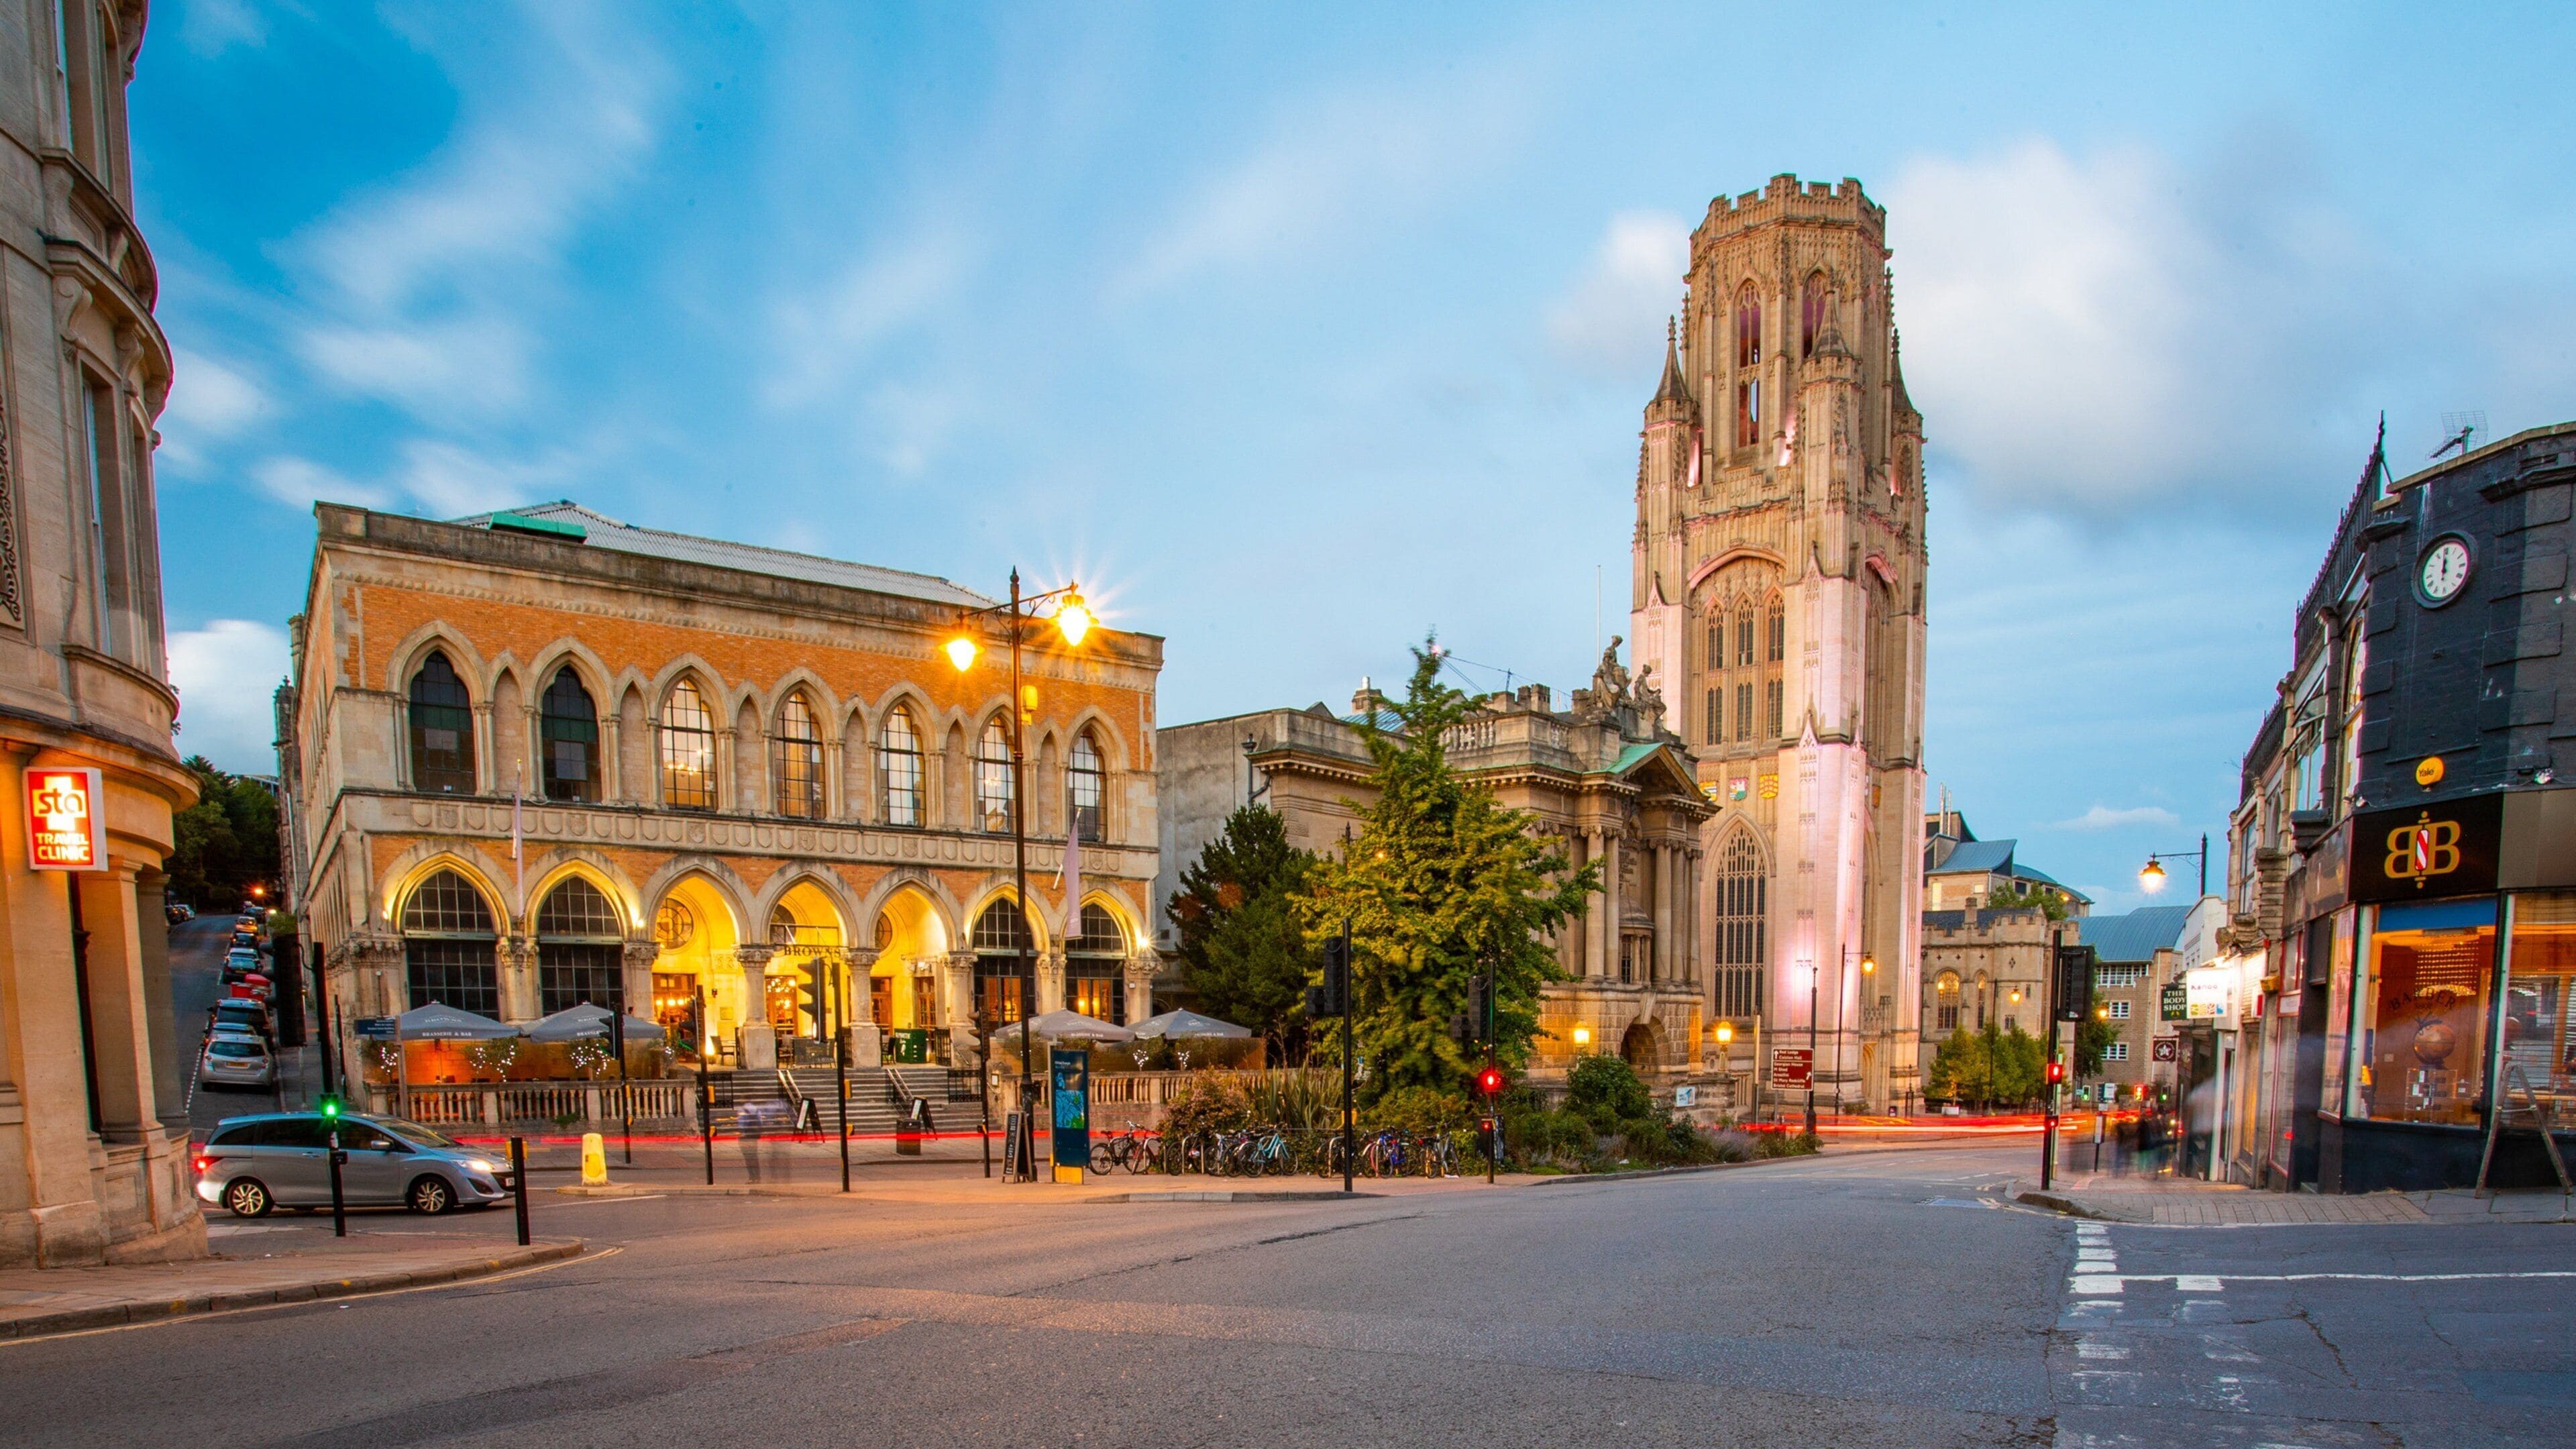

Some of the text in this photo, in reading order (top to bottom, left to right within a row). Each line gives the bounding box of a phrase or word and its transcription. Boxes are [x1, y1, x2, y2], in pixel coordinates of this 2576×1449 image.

[2419, 768, 2434, 777] Yale
[38, 788, 83, 814] sta
[35, 833, 89, 845] TRAVEL
[37, 845, 90, 861] CLINIC
[784, 946, 841, 957] BROWNS
